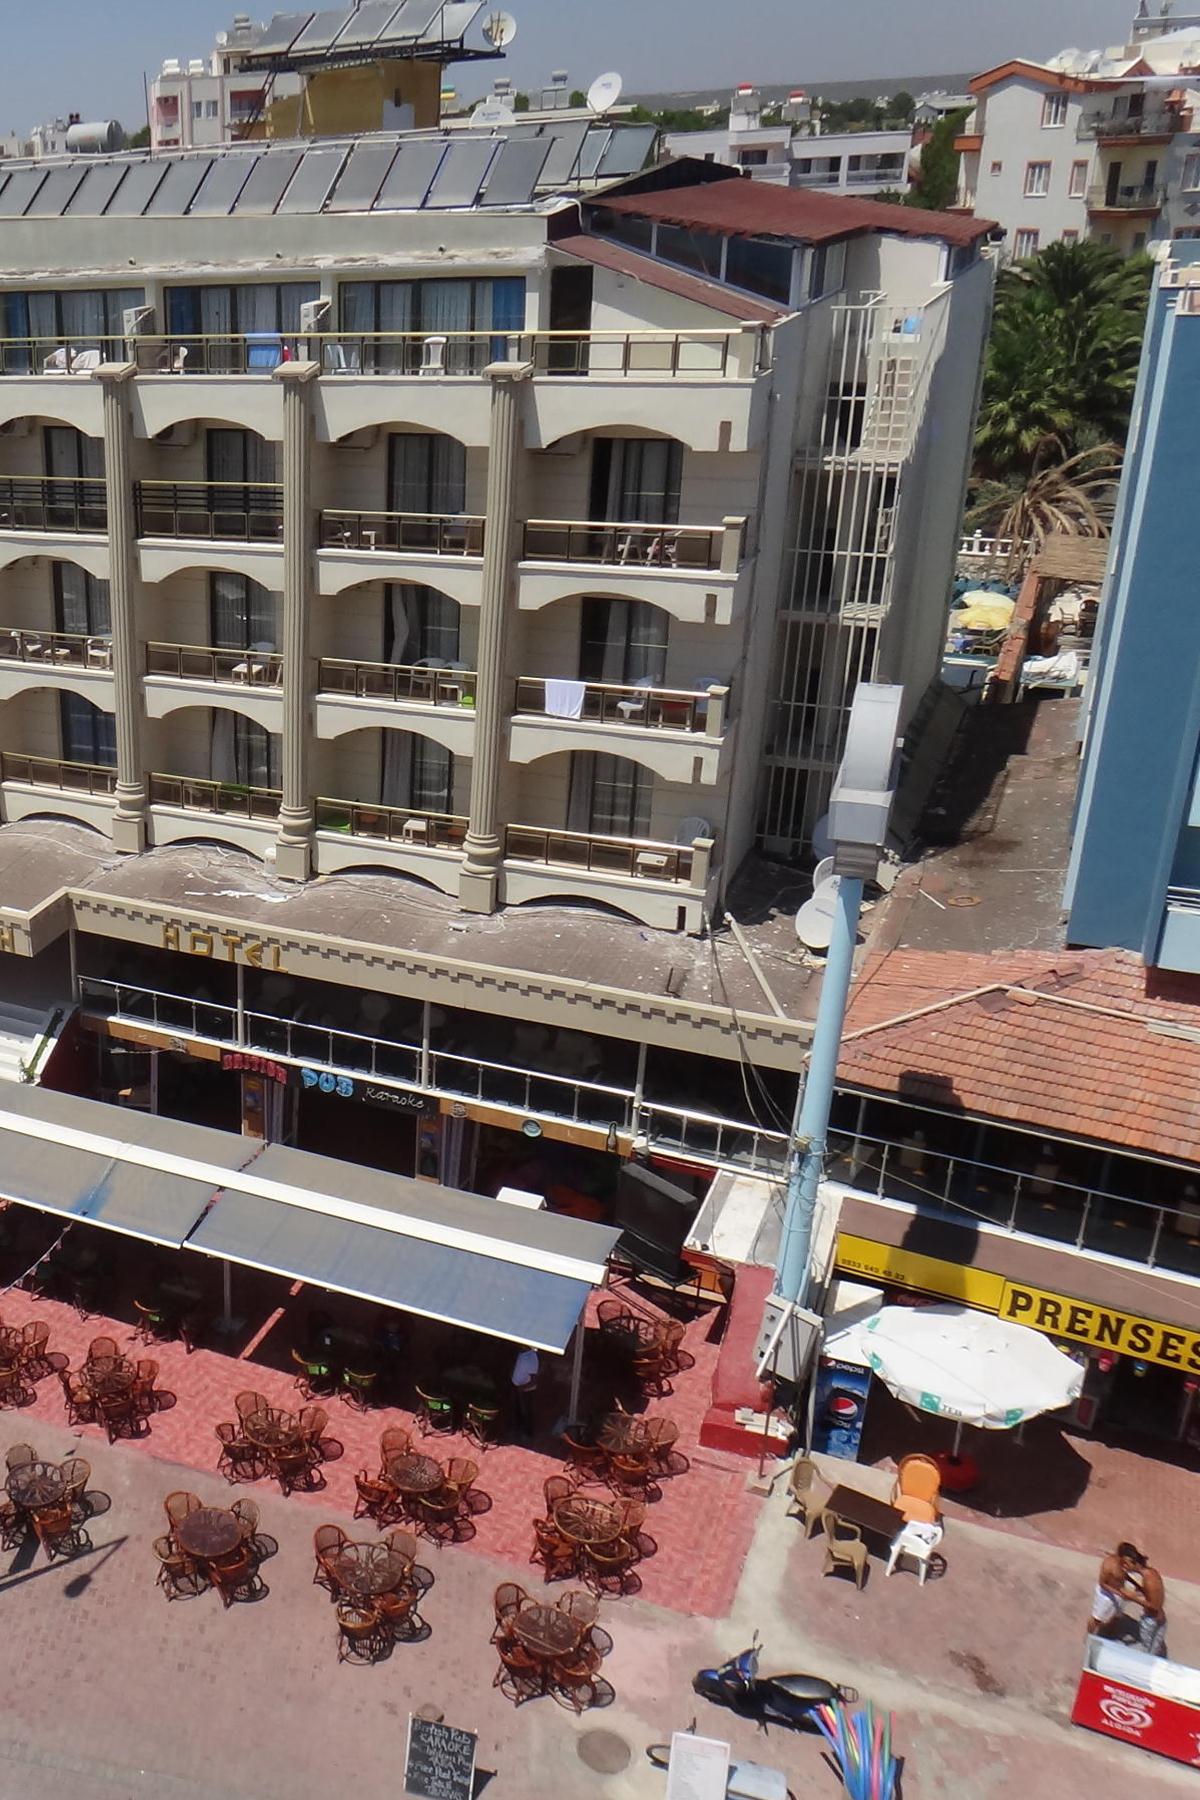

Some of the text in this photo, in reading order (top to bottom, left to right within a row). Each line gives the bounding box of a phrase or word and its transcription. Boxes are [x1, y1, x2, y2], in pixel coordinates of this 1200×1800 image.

[161, 923, 289, 974] HOTEL
[301, 1067, 354, 1097] PUB
[365, 1086, 424, 1109] Karaoke
[836, 1362, 865, 1374] pepsi
